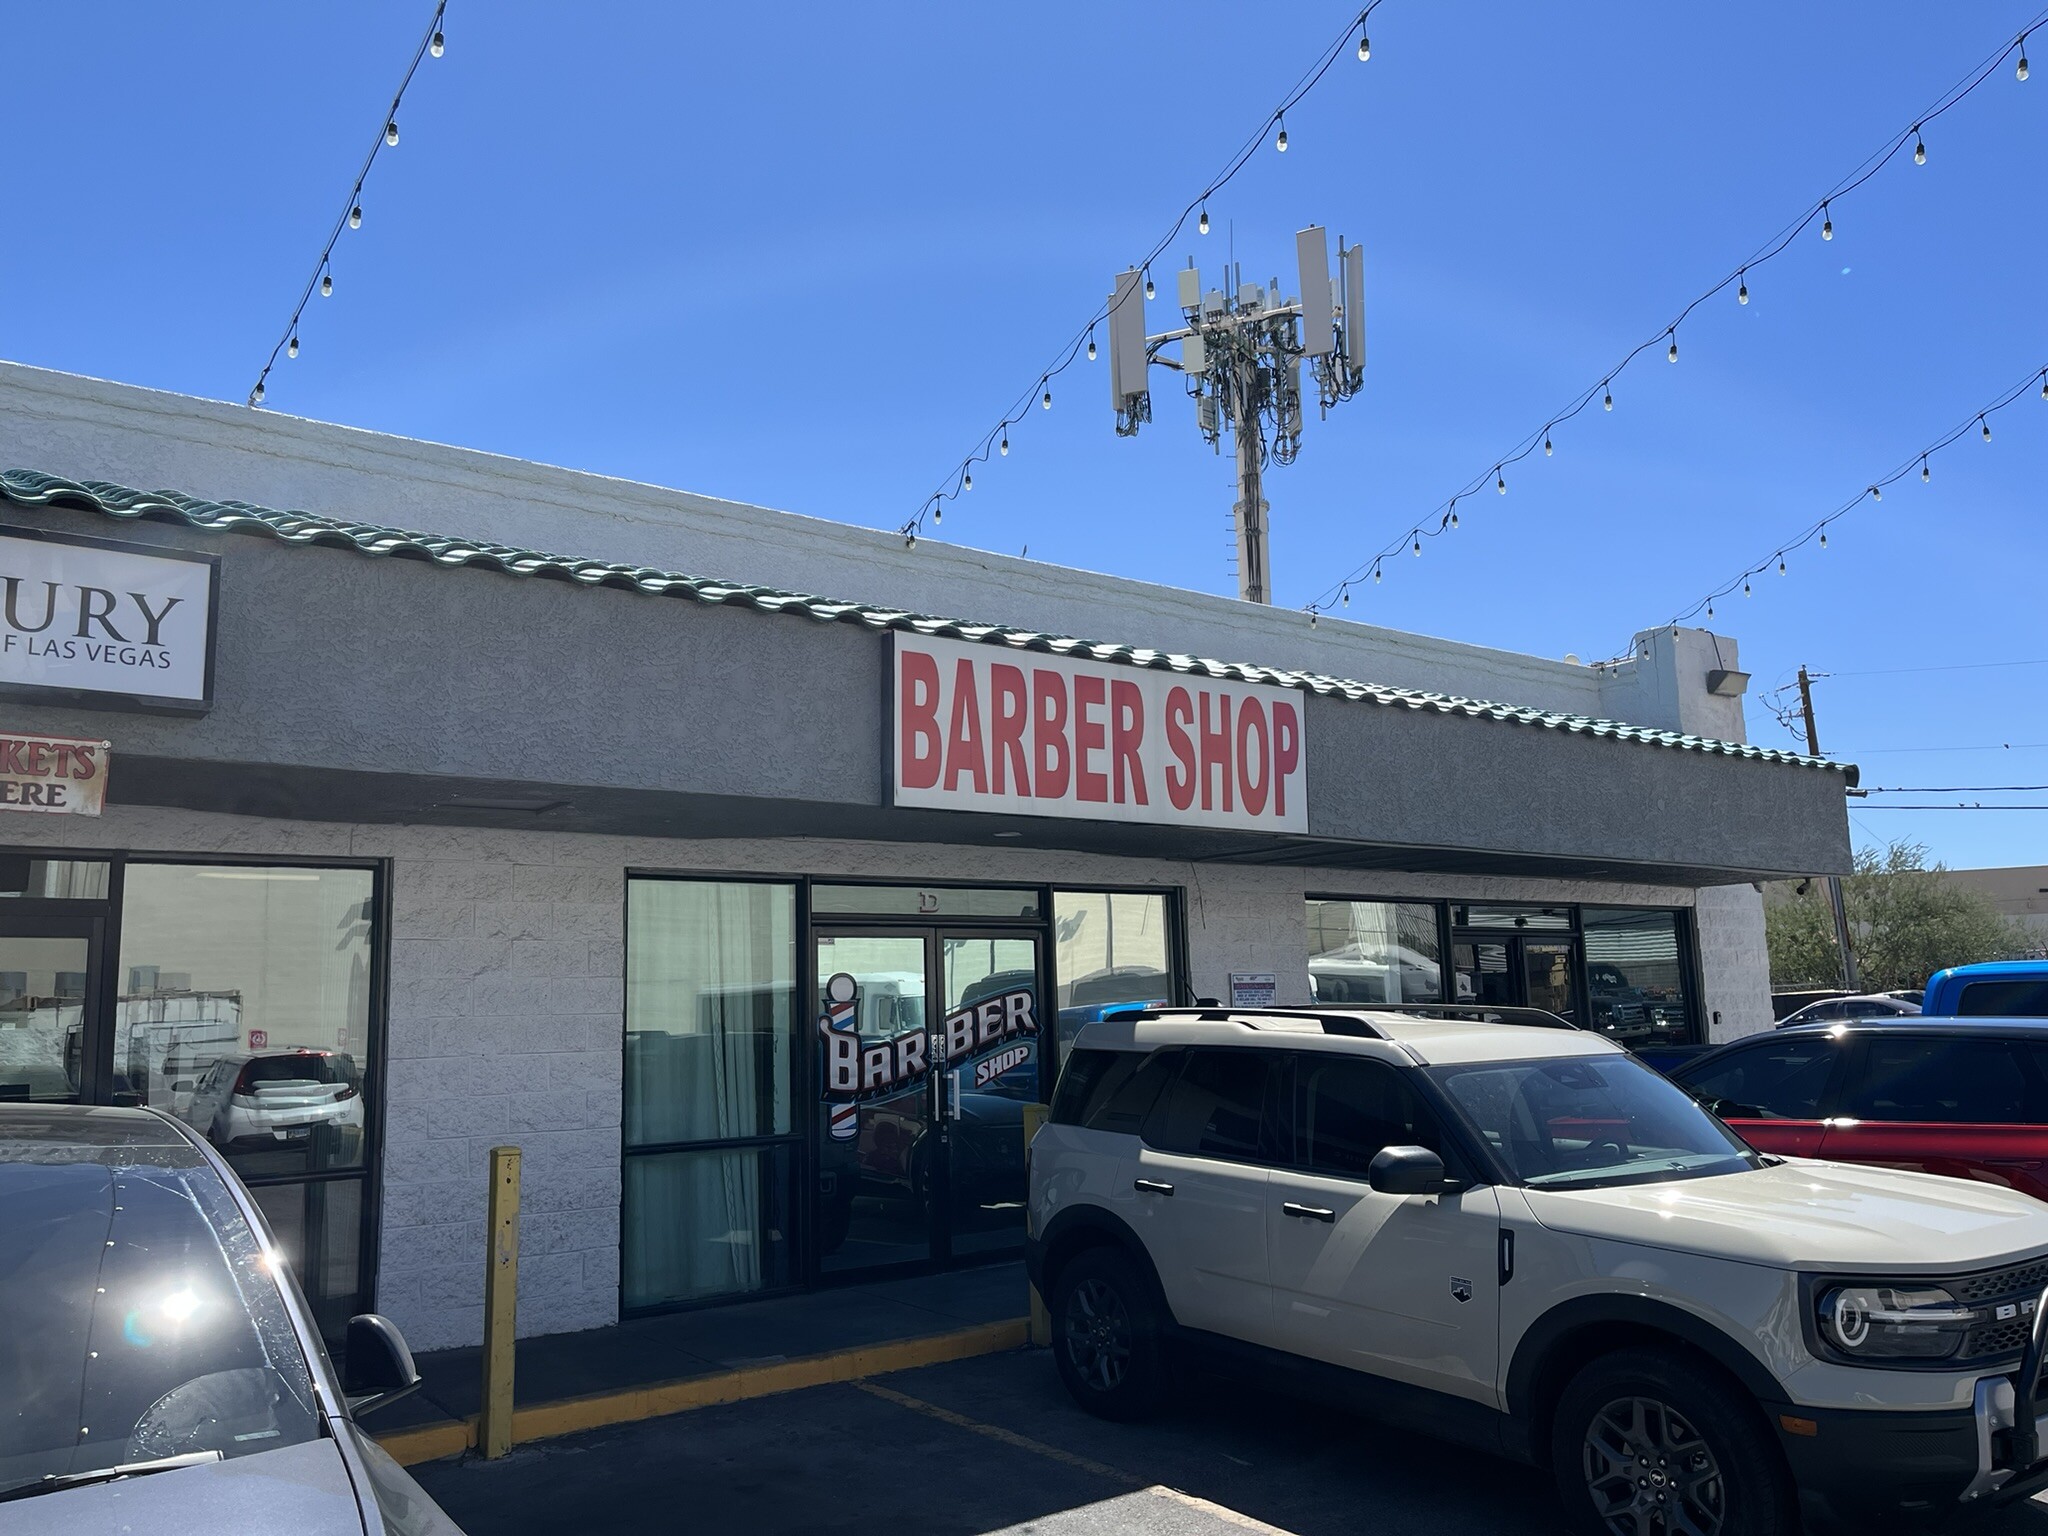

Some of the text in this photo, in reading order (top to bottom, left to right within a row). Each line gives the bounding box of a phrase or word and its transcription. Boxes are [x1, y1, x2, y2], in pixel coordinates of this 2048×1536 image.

[0, 575, 185, 647] URY
[28, 636, 77, 659] LAS
[85, 642, 171, 669] VEGAS
[901, 650, 1299, 816] BARBER SHOP
[0, 740, 96, 780] KETS
[0, 780, 67, 807] ERE
[819, 991, 1040, 1090] BARBER
[976, 1046, 1029, 1087] SHOP
